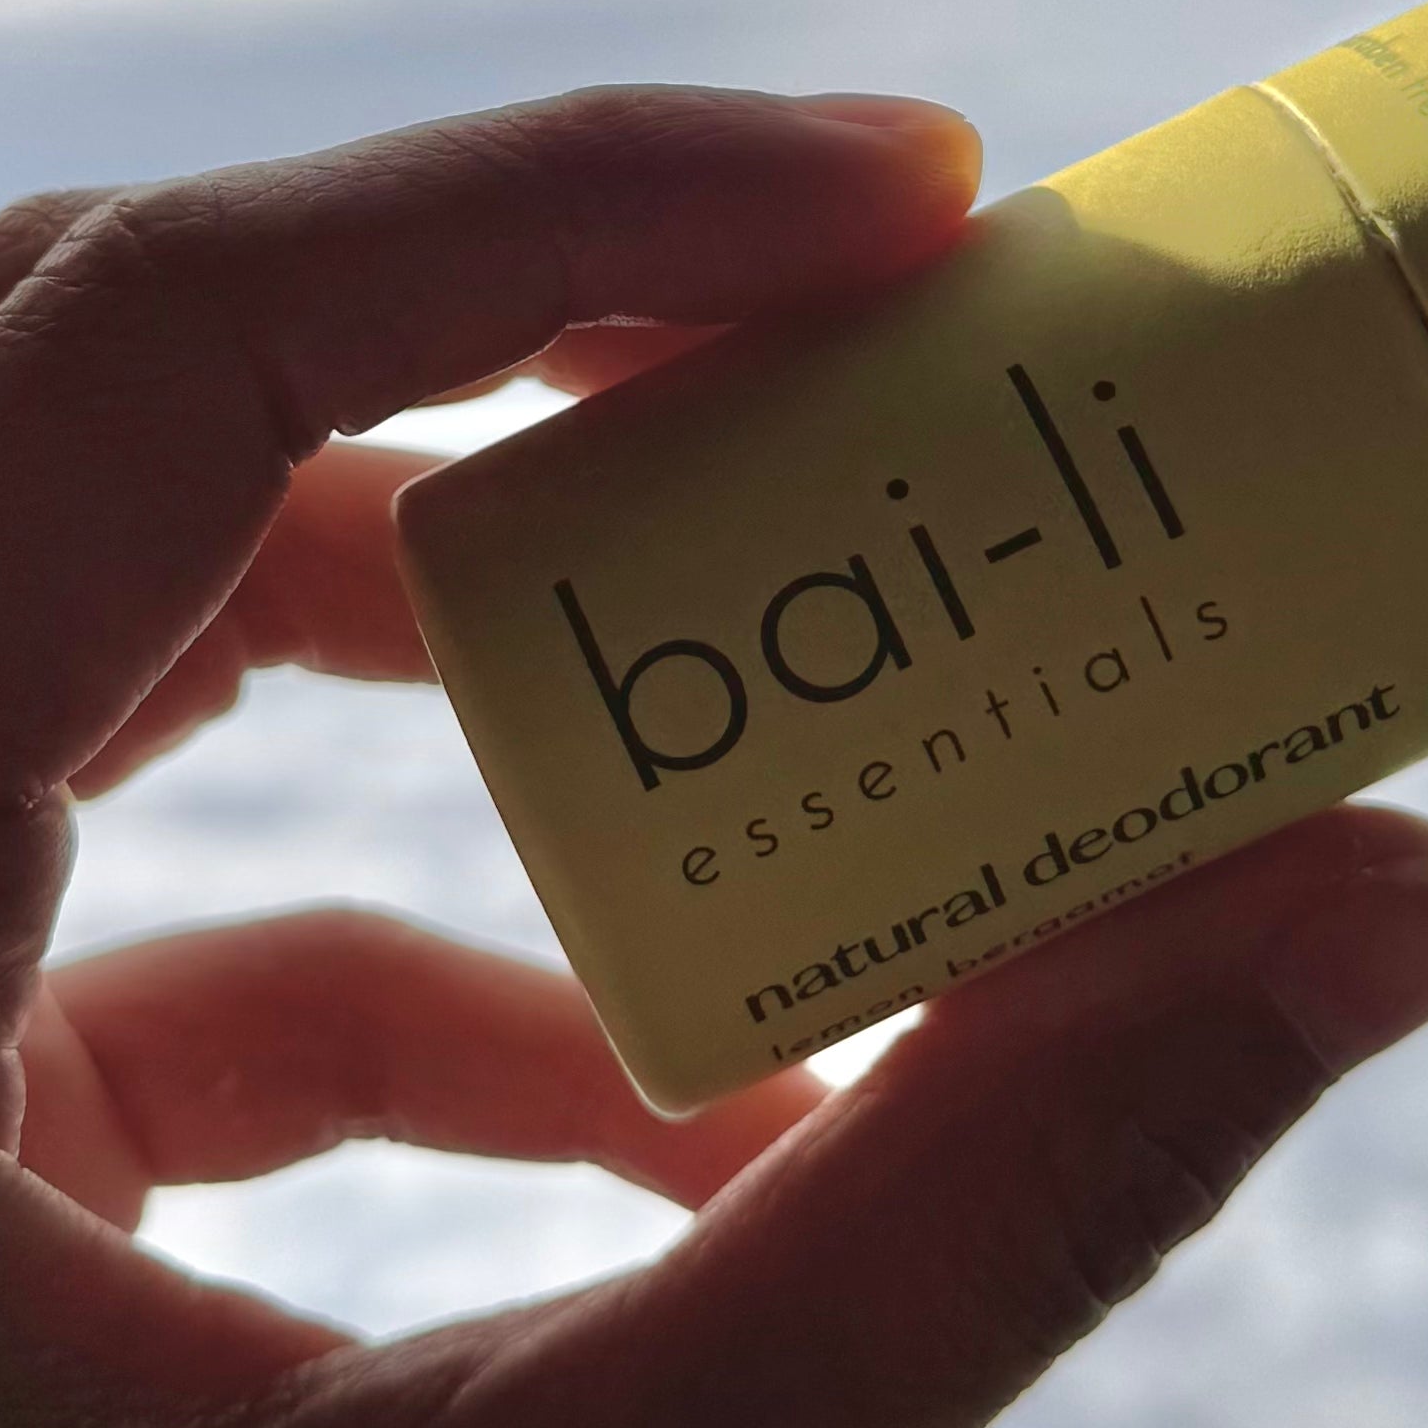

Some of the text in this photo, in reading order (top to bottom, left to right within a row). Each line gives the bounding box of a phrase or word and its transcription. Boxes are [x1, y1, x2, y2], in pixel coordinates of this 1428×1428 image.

[554, 364, 1185, 791] bai-li
[681, 594, 1230, 886] essentials
[745, 682, 1402, 1025] natural deodorant
[772, 849, 1194, 1062] lemon bergamot
